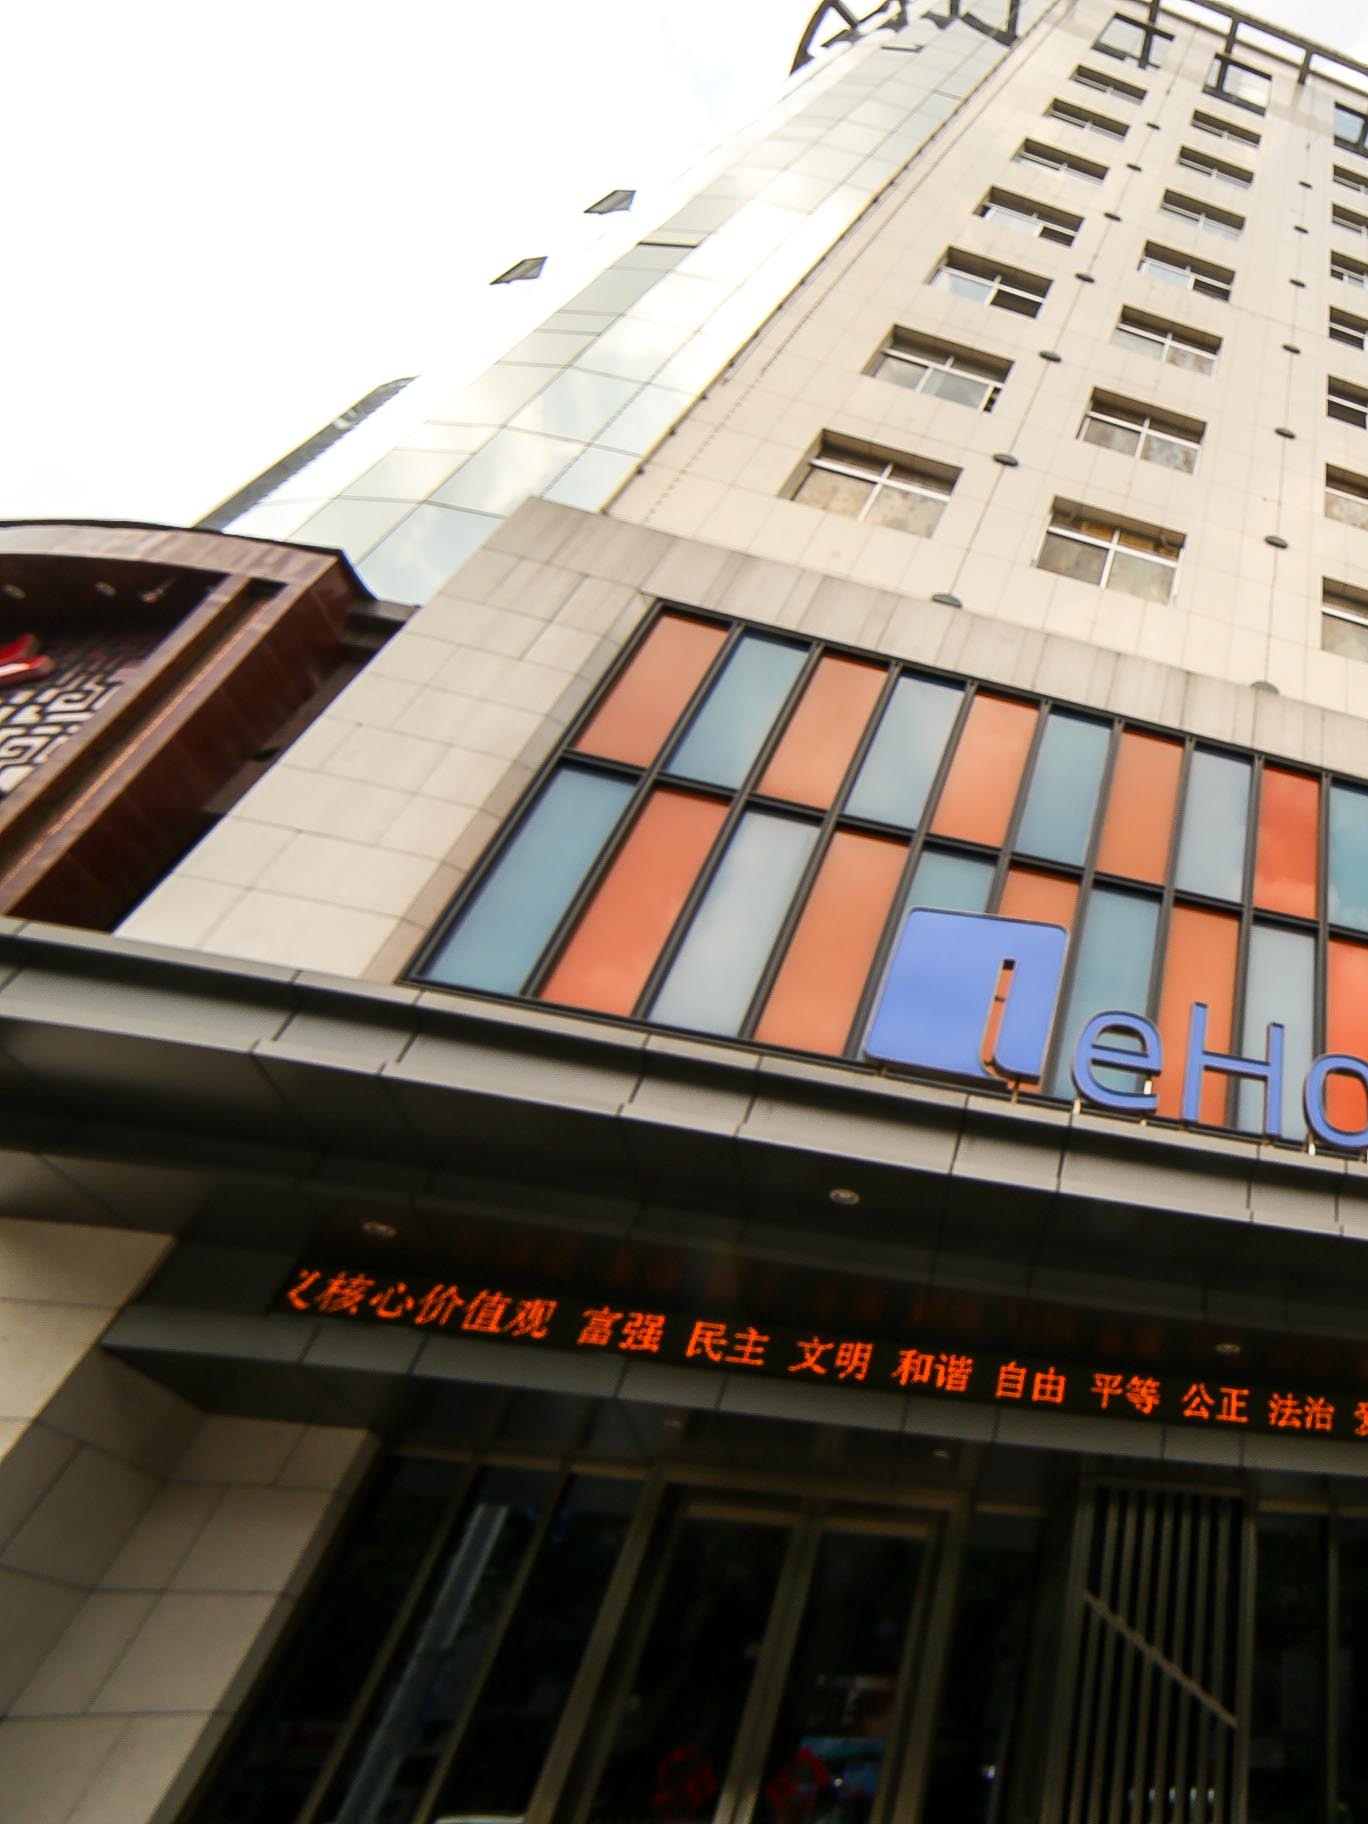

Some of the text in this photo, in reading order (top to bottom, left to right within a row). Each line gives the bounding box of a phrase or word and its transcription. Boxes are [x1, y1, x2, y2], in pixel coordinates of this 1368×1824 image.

[577, 1306, 666, 1353] 富强
[685, 1320, 770, 1366] 民主
[788, 1337, 874, 1381] 文明
[891, 1349, 974, 1392] 和谐
[995, 1360, 1067, 1404] 自由
[1091, 1373, 1160, 1415] 平等
[1182, 1383, 1249, 1423] 公正
[1268, 1393, 1335, 1431] 法治
